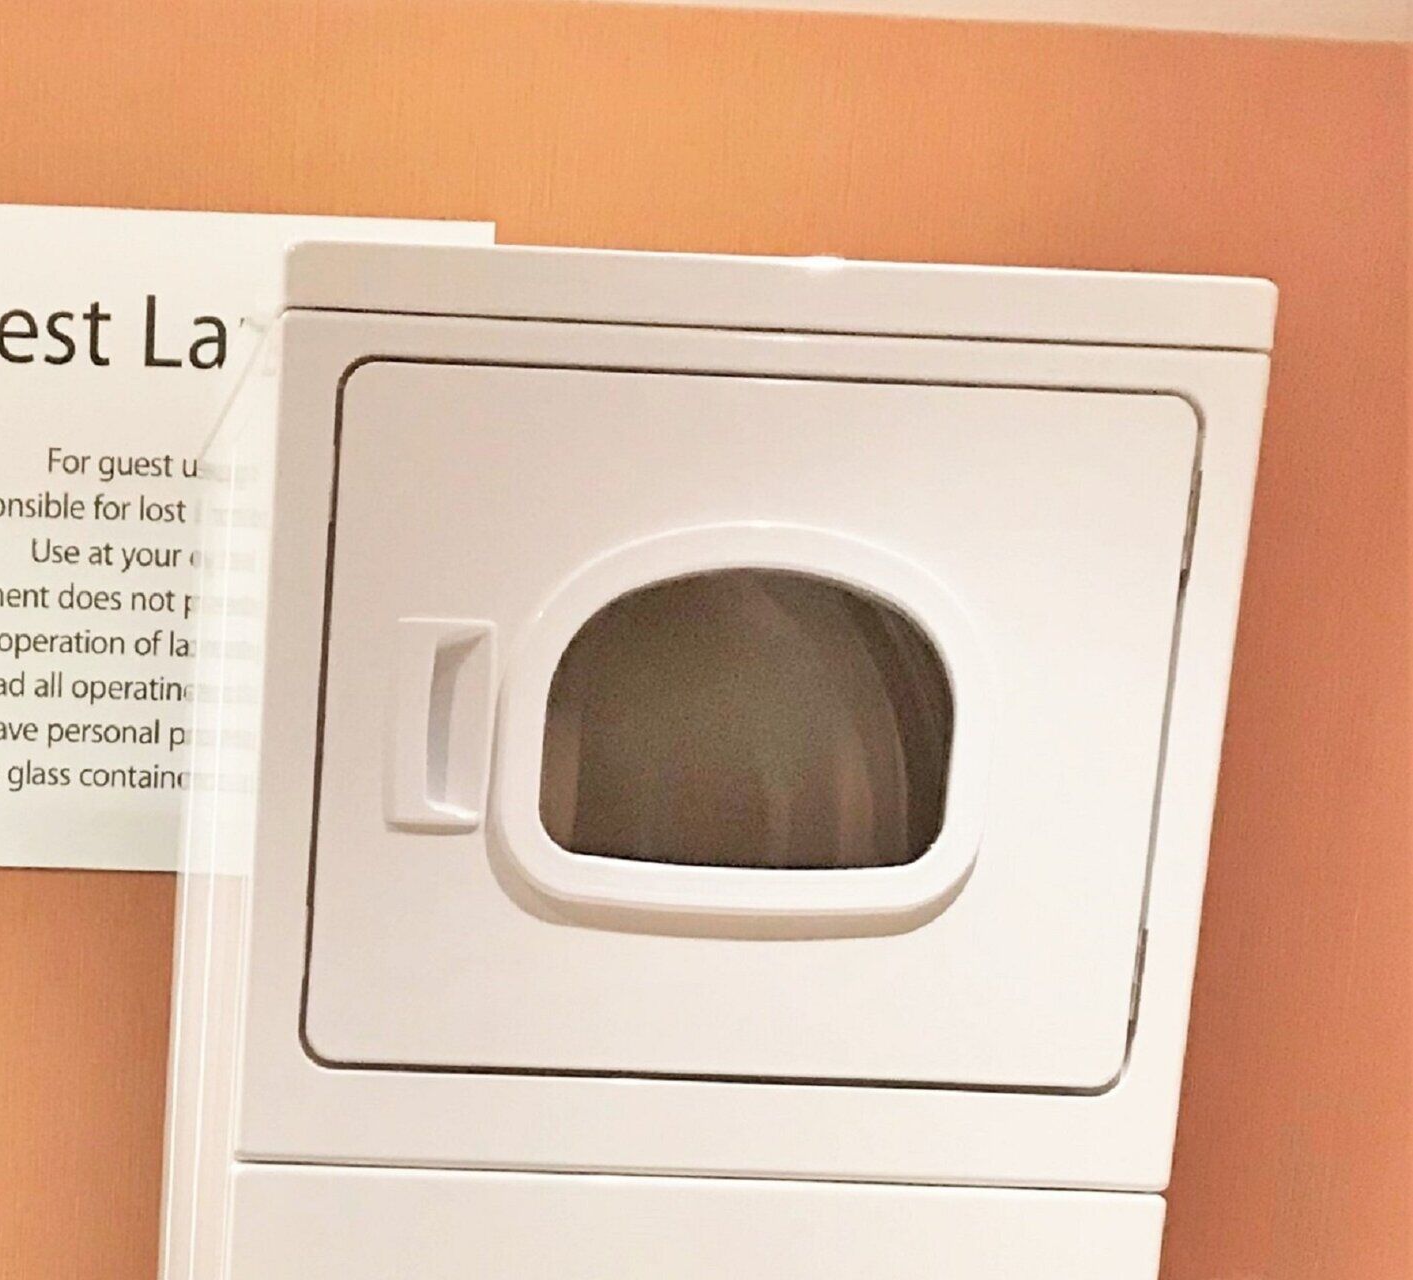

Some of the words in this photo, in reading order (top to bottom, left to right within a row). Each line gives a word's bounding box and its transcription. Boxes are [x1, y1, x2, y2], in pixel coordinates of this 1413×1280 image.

[144, 294, 227, 370] La
[48, 447, 91, 475] For
[98, 454, 173, 482] guest
[93, 493, 131, 521] for
[139, 495, 186, 523] lost
[31, 538, 80, 564] Use
[88, 543, 114, 566] at
[121, 547, 182, 573] your
[58, 583, 122, 611] does
[131, 590, 175, 613] not
[134, 629, 163, 656] of
[169, 631, 189, 658] la
[34, 671, 62, 698] all
[47, 719, 160, 748] personal
[7, 759, 71, 792] glass
